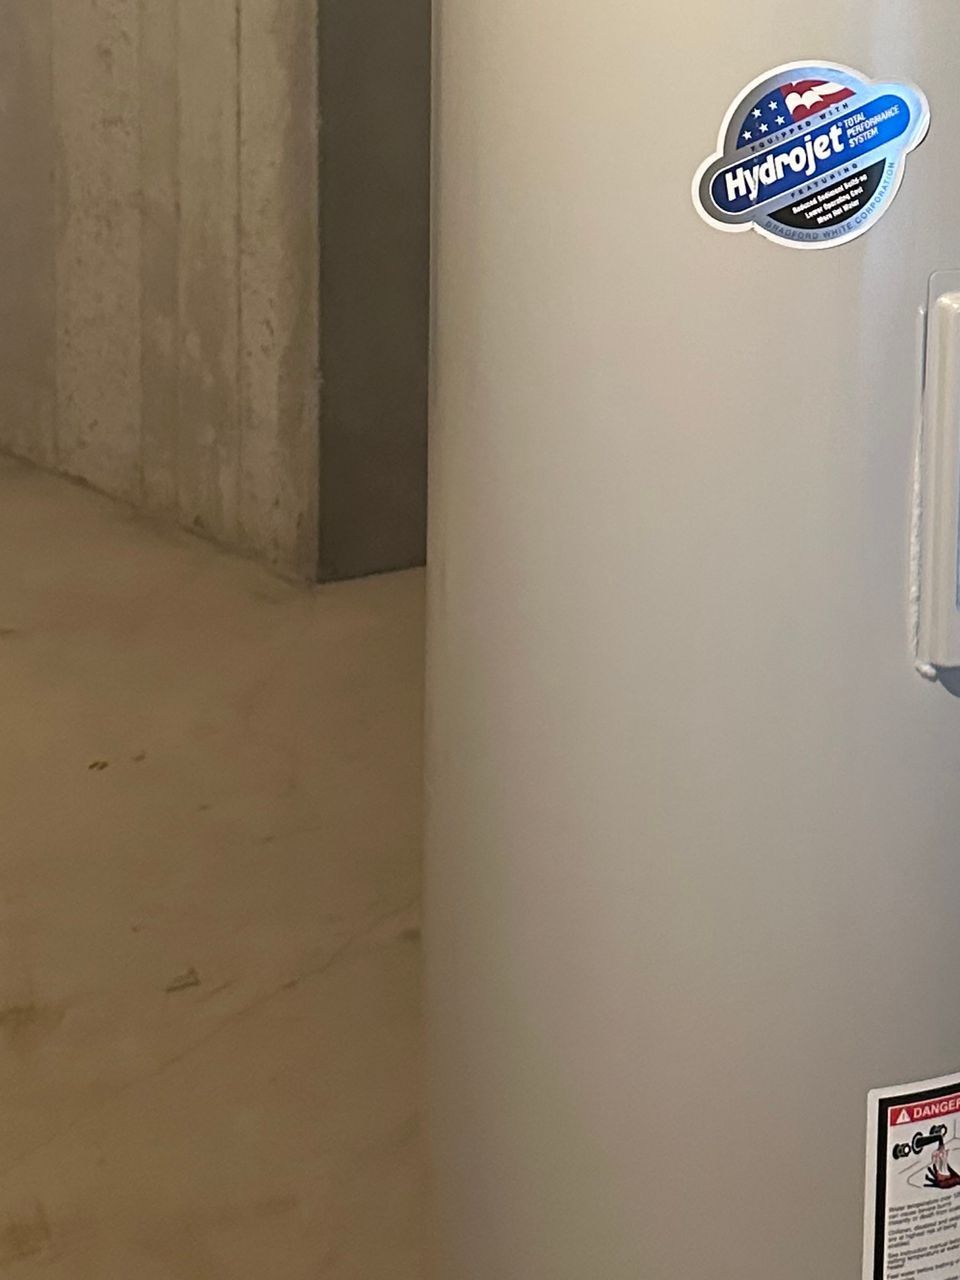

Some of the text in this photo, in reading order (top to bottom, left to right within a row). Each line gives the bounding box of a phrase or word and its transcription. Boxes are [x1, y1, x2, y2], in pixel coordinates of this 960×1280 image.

[750, 103, 849, 151] EQUIPPED WITH
[843, 112, 867, 128] TOTAL
[848, 127, 879, 147] SYSTEM
[725, 124, 844, 201] Hydrojet
[790, 163, 858, 198] FEATURING
[764, 161, 896, 240] BRADFORD WHITE CORPORATION
